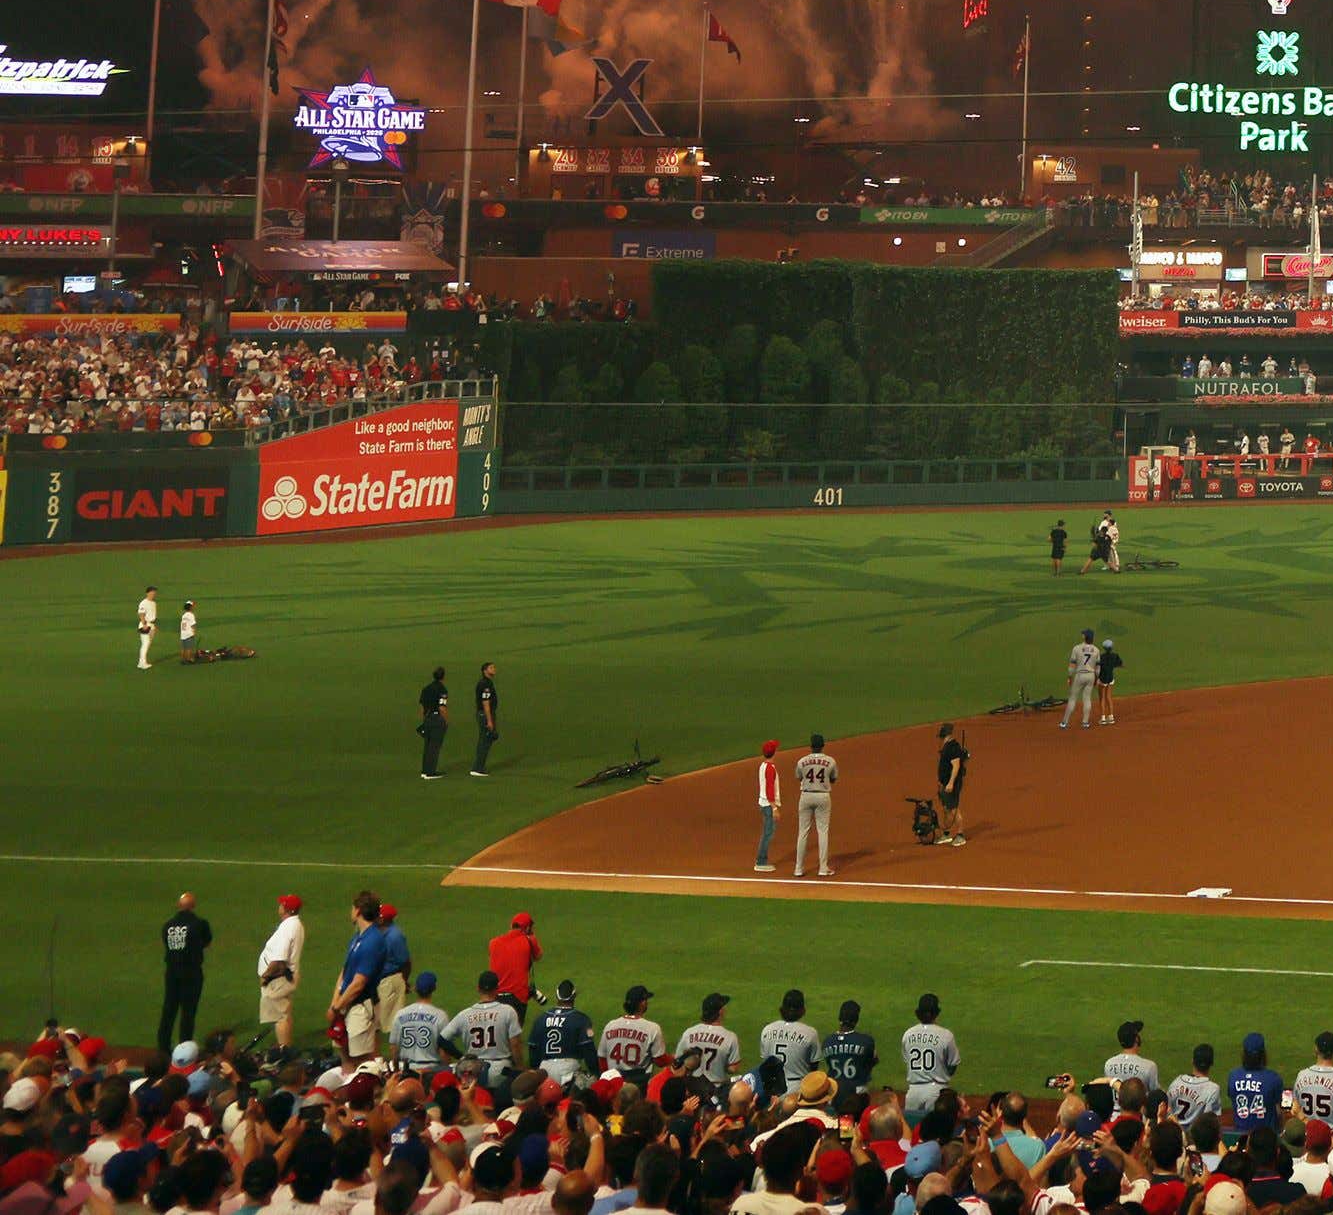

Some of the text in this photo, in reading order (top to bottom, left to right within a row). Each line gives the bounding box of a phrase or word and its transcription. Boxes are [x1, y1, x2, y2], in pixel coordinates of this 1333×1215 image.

[1168, 83, 1296, 115] Citizens
[294, 105, 425, 130] ALL STAR GAME
[1240, 121, 1309, 151] Park
[1055, 157, 1077, 176] 42
[200, 200, 234, 213] NFP
[26, 229, 100, 240] LUKE'S
[645, 247, 704, 259] Extreme
[352, 273, 369, 281] GAME
[268, 314, 333, 331] Surfside
[1184, 316, 1288, 326] Philly, This Bud's For You
[1194, 382, 1283, 395] NUTRAFOL
[355, 419, 455, 436] Like a good neighbor,
[463, 426, 484, 447] ANGLE
[359, 438, 424, 455] State Farm is
[1260, 482, 1304, 492] TOYOTA
[76, 488, 226, 520] GIANT
[814, 487, 843, 507] 401
[805, 768, 826, 783] 44
[167, 926, 187, 936] CSC
[402, 1026, 431, 1049] 53
[470, 1025, 497, 1049] 31
[546, 1029, 562, 1054] 2
[605, 1030, 648, 1043] CONTRERAS
[689, 1033, 725, 1047] BAZZANA
[610, 1043, 642, 1067] 40
[776, 1044, 788, 1064] 5
[910, 1049, 935, 1071] 20
[832, 1058, 857, 1078] 56
[1235, 1080, 1262, 1092] CEASE
[1177, 1099, 1191, 1121] 7
[1236, 1094, 1266, 1119] 84
[1301, 1093, 1332, 1117] 35
